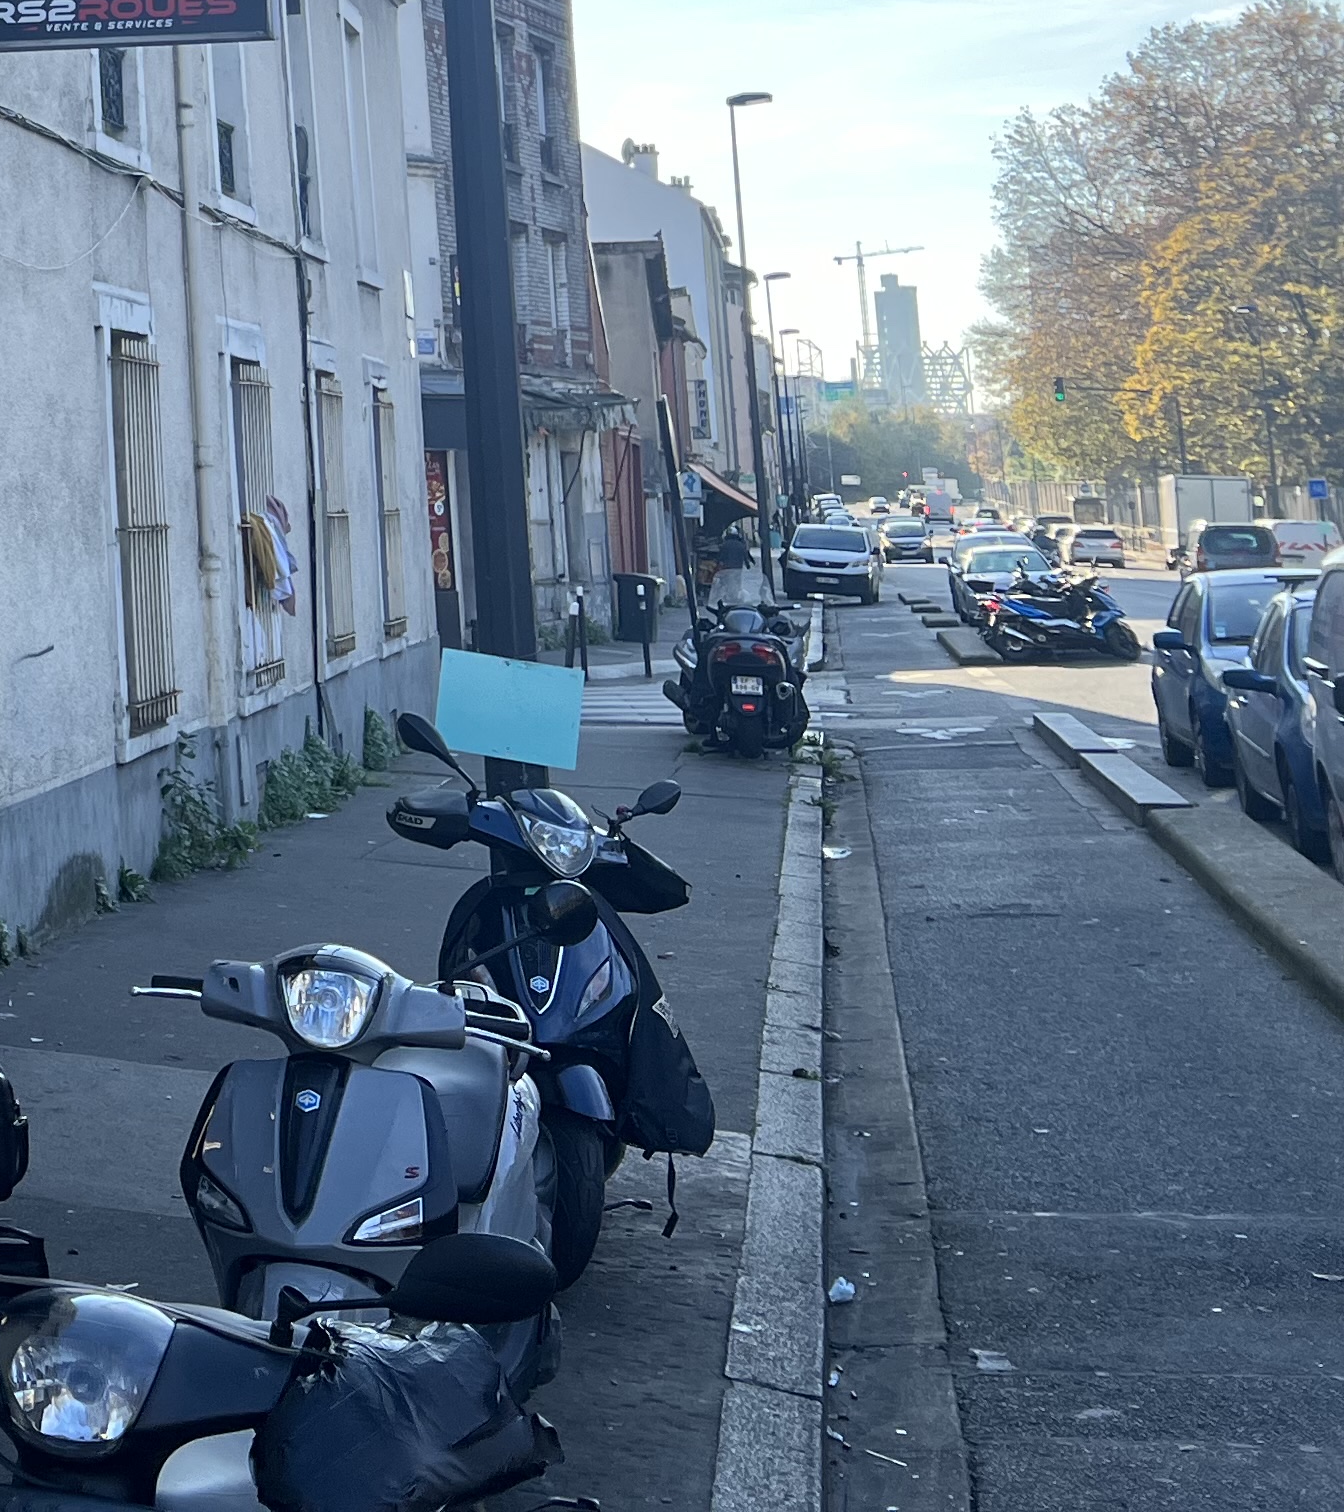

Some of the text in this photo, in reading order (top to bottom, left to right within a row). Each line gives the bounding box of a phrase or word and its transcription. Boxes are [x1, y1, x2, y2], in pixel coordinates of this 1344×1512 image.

[45, 20, 90, 33] VENTE
[106, 18, 174, 31] SERVICES
[398, 813, 424, 826] SHAD
[404, 1166, 420, 1179] S
